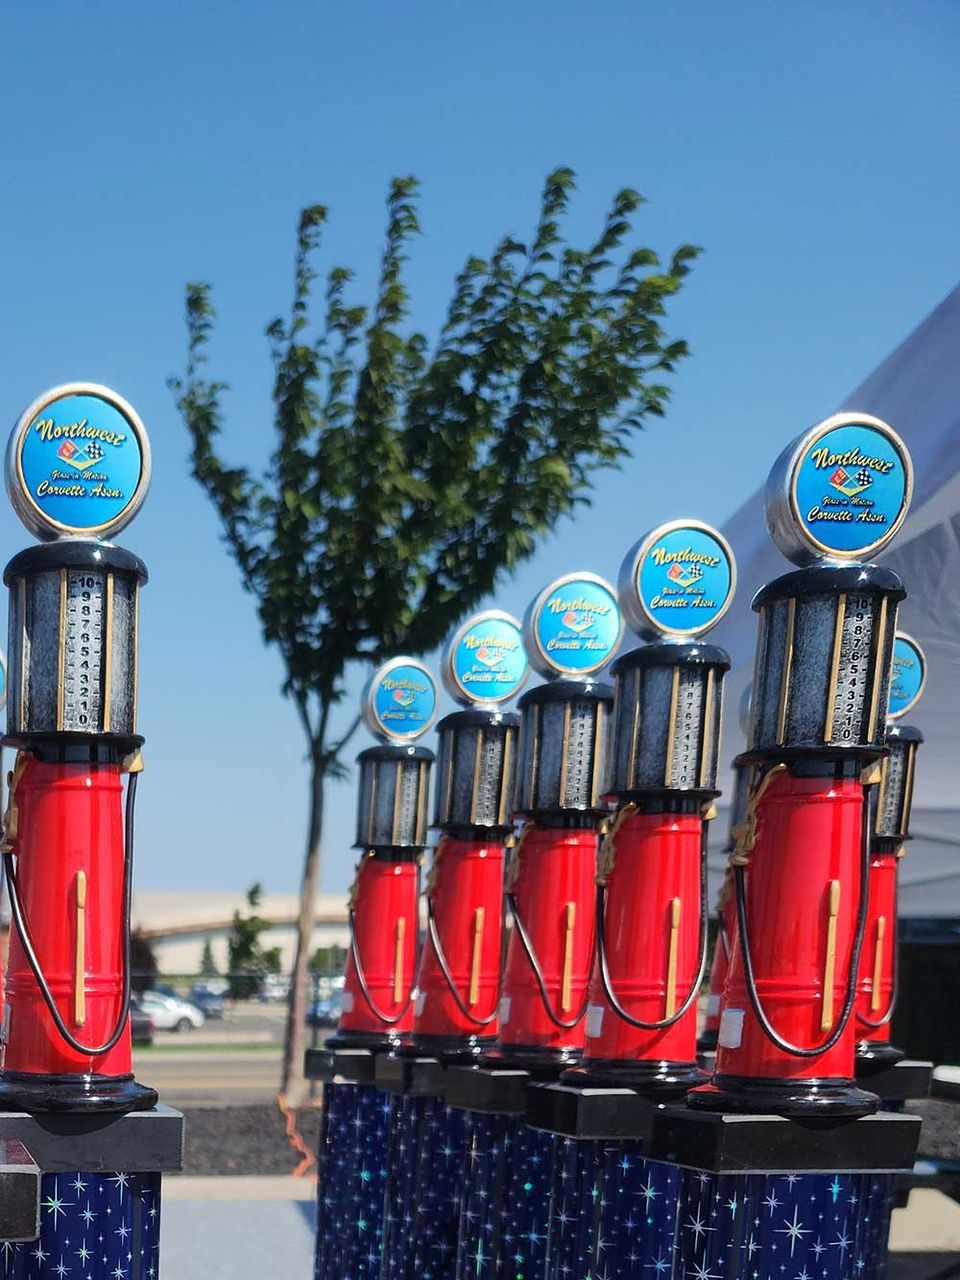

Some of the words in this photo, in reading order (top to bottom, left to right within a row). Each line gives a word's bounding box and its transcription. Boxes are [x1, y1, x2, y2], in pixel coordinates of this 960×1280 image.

[35, 419, 126, 446] Northwest
[811, 447, 894, 473] Northwest
[37, 480, 86, 496] Corvette
[89, 483, 124, 497] Assn.
[807, 506, 852, 522] Corvette
[855, 508, 886, 522] Assn.
[651, 546, 720, 567] Northwest
[79, 577, 95, 588] 10
[81, 591, 91, 602] 9
[650, 596, 687, 609] Corvette
[855, 599, 868, 610] 10
[81, 605, 91, 616] 8
[855, 612, 864, 622] 9
[81, 619, 90, 629] 7
[854, 625, 863, 635] 8
[80, 633, 90, 643] 6
[853, 638, 862, 648] 7
[80, 647, 90, 657] 5
[851, 651, 860, 661] 6
[80, 660, 90, 671] 4
[850, 664, 858, 674] 5
[80, 674, 89, 684] 3
[849, 677, 857, 688] 4
[79, 688, 89, 697] 2
[847, 690, 855, 700] 3
[80, 701, 88, 711] 1
[846, 703, 854, 713] 2
[79, 714, 88, 725] 0
[845, 716, 852, 727] 1
[843, 729, 851, 739] 0
